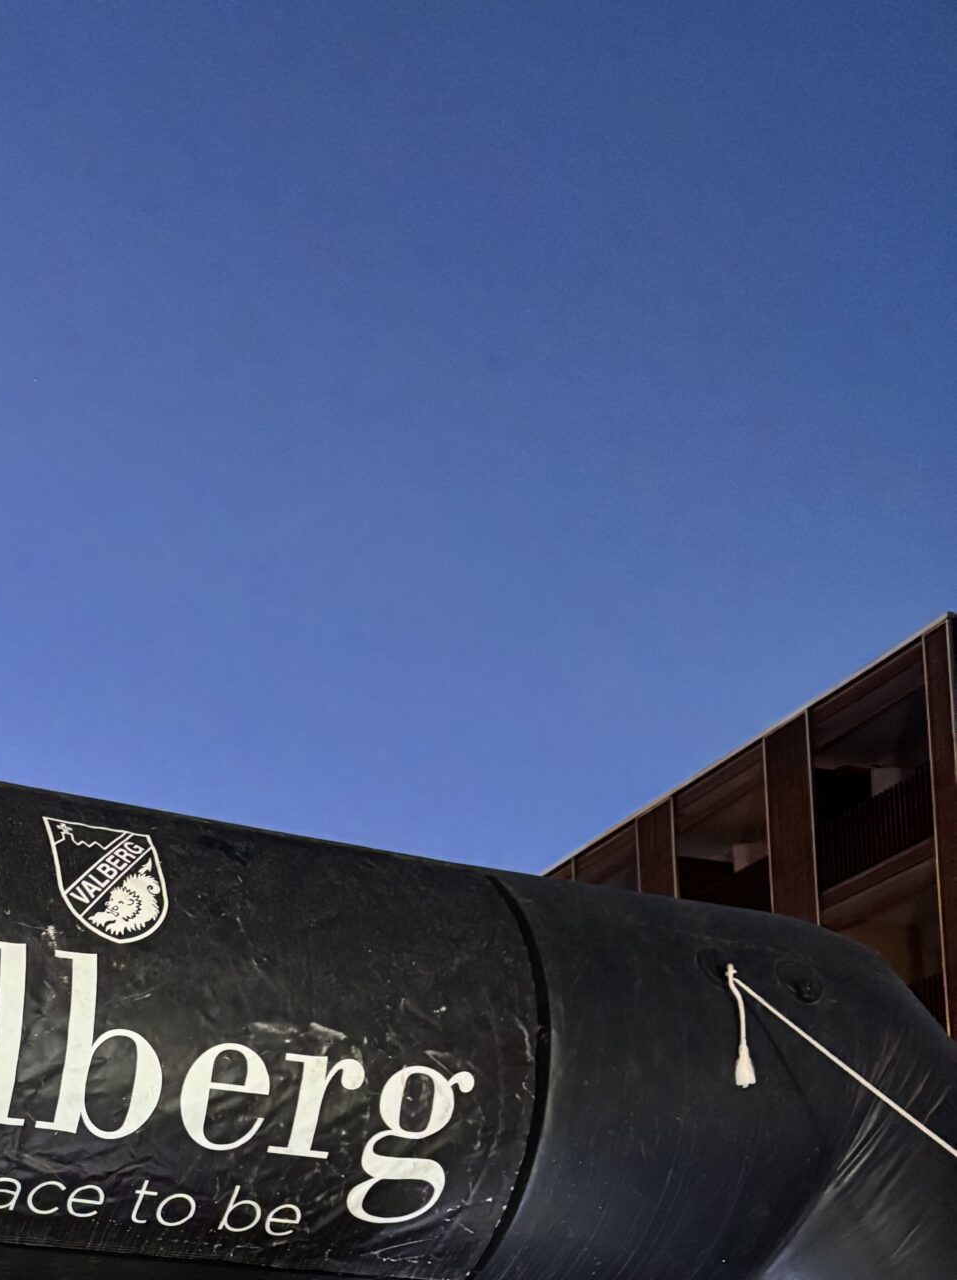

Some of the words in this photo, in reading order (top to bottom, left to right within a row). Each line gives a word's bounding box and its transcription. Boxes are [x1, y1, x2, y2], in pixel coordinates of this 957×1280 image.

[69, 841, 145, 904] VALBERG
[132, 1178, 197, 1226] to
[218, 1186, 302, 1236] be
